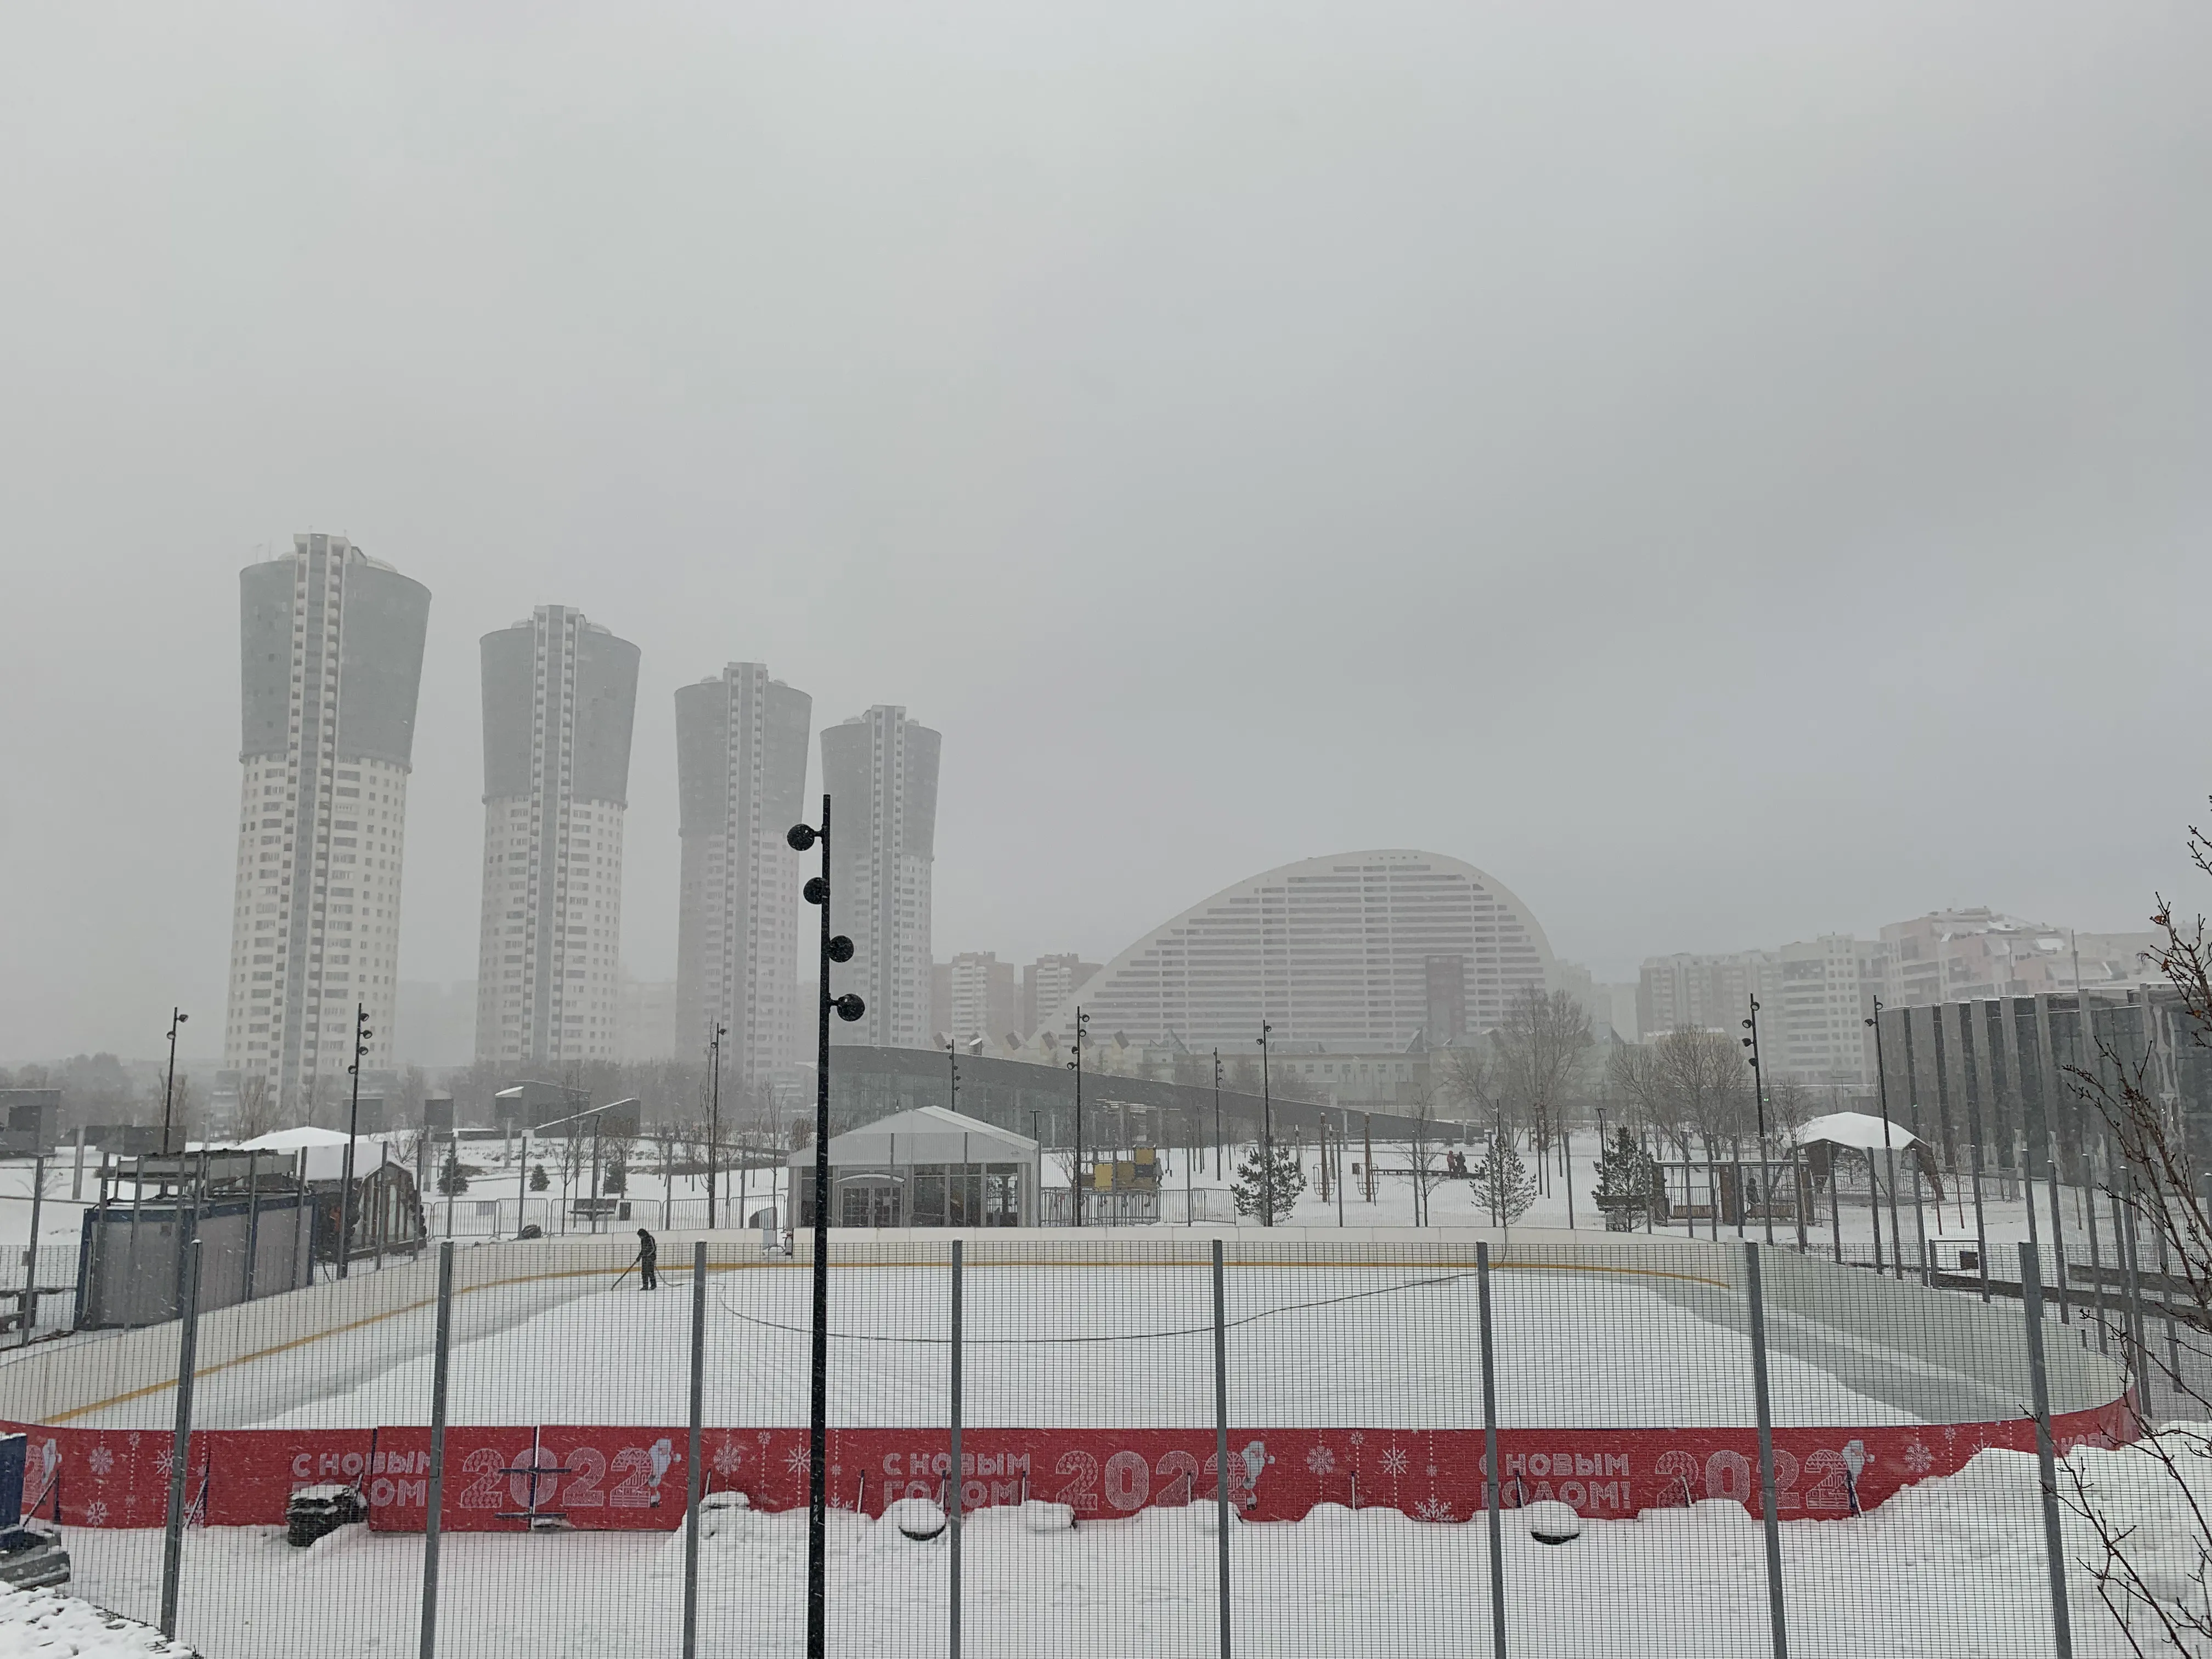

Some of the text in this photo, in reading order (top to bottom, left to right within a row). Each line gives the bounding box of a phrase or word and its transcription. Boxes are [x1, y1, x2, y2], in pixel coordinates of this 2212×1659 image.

[292, 1453, 312, 1477] С
[460, 1448, 651, 1508] 2022
[883, 1453, 1030, 1476] С НОВЫМ
[1056, 1451, 1247, 1510] 2022
[1506, 1453, 1629, 1476] НОВЫМ
[1655, 1449, 1850, 1509] 2022
